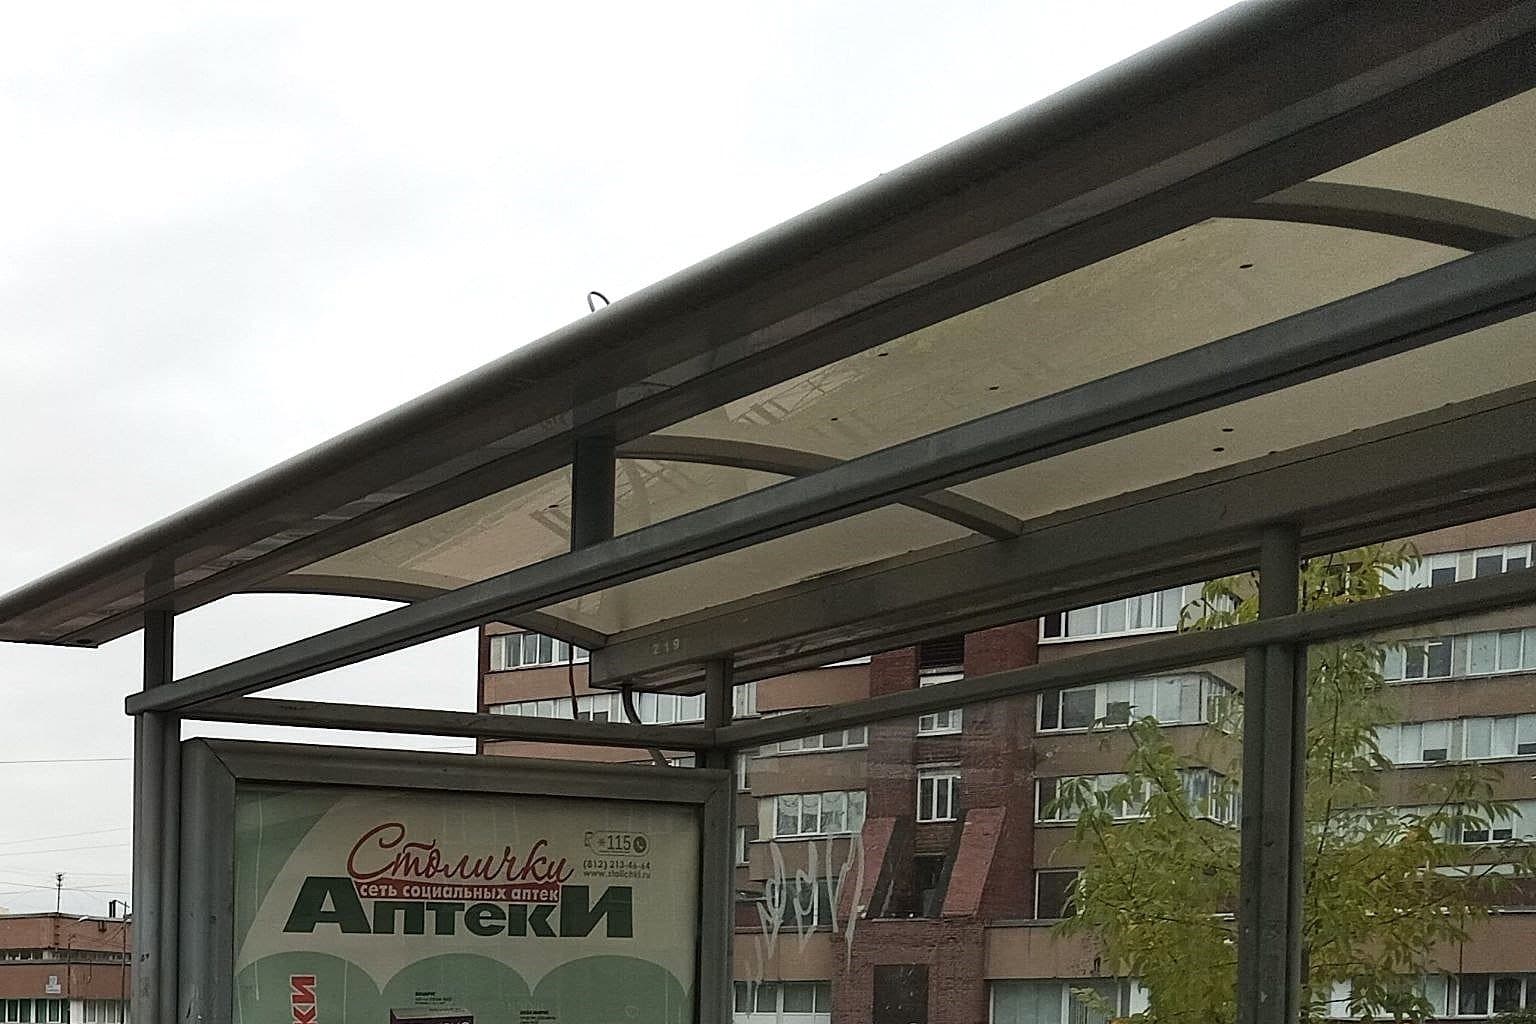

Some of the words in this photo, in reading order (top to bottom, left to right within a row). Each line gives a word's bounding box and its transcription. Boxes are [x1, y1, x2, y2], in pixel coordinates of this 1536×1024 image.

[346, 822, 575, 883] Столички
[360, 883, 397, 898] сеть
[402, 884, 507, 900] социальных
[511, 886, 559, 901] аптек
